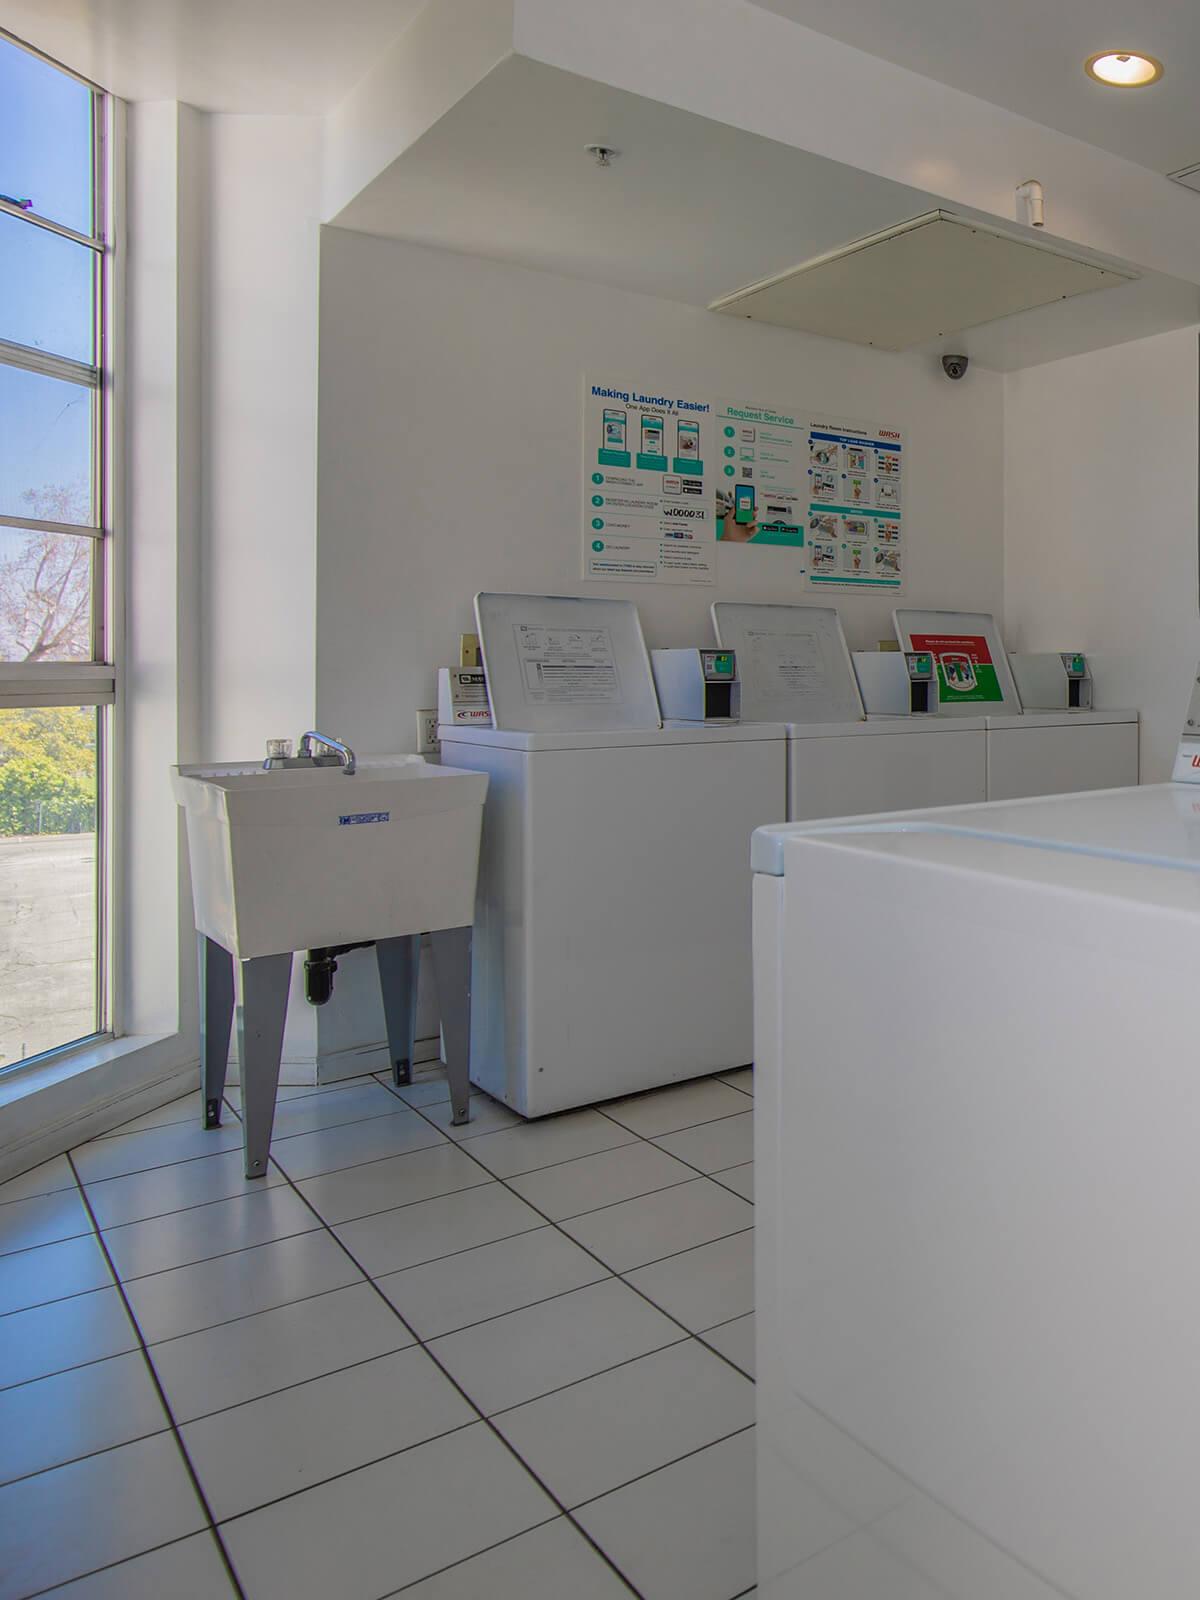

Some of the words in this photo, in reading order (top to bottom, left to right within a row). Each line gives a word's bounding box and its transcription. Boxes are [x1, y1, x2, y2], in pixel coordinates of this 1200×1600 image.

[592, 386, 629, 402] Making
[632, 392, 674, 409] Laundry
[677, 400, 710, 413] Easier!
[651, 406, 666, 414] Does
[727, 407, 762, 419] Request
[764, 412, 794, 424] Service
[810, 422, 828, 430] Laundry
[843, 427, 867, 435] Instructions
[879, 430, 901, 438] WASH
